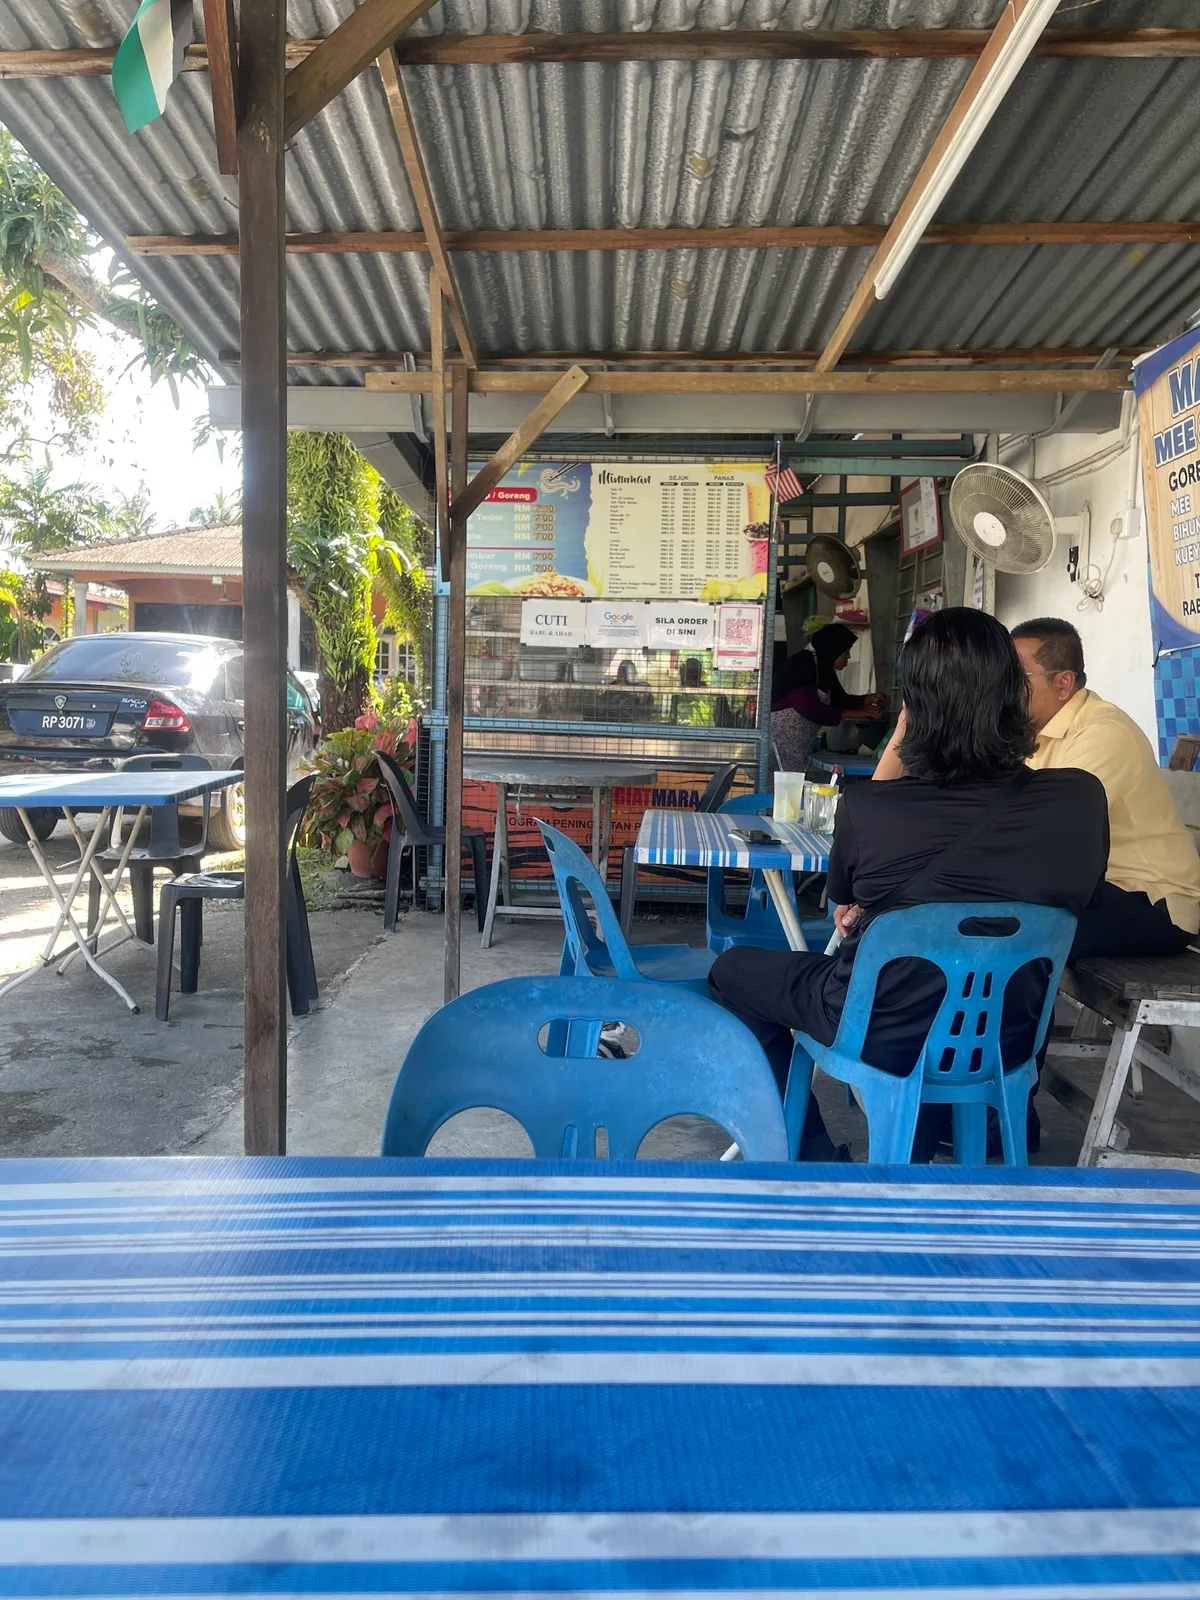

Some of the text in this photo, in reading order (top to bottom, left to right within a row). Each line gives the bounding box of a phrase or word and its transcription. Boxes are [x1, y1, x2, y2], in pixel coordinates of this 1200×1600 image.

[1153, 416, 1197, 468] MEE
[598, 470, 651, 484] Minuman
[498, 492, 530, 500] Goreng
[1171, 494, 1191, 518] MEE
[1175, 542, 1200, 566] KUEY
[470, 562, 507, 572] Goreng
[535, 614, 567, 626] CUTI
[604, 612, 633, 622] Google
[42, 716, 84, 729] RP 3071
